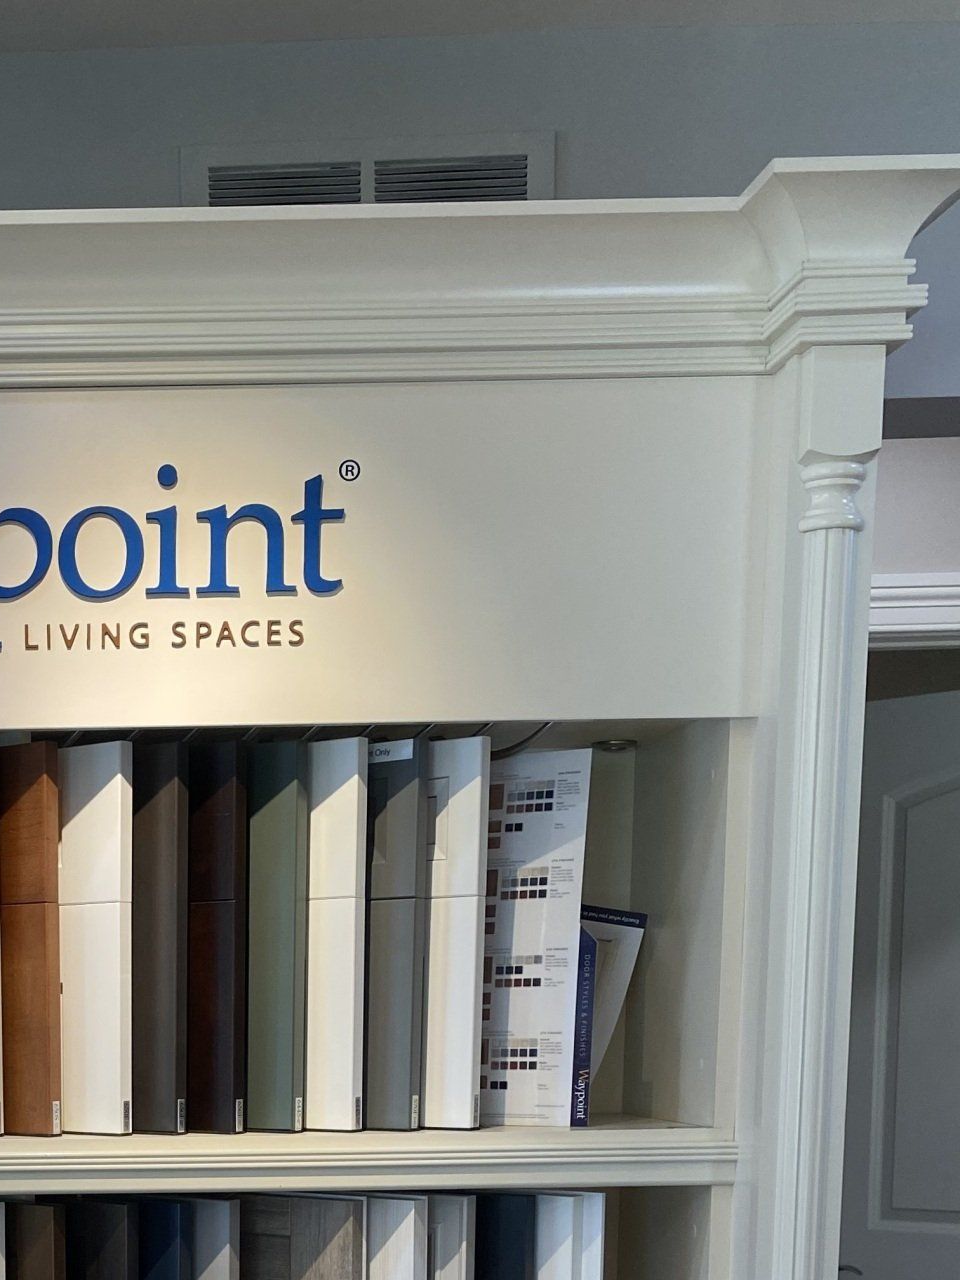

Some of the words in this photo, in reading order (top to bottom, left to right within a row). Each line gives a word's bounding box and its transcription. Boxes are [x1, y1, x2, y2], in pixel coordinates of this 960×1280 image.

[24, 622, 150, 650] LIVING
[171, 619, 305, 648] SPACES
[374, 748, 391, 757] Only
[583, 954, 591, 977] DOOR
[582, 981, 590, 1009] STYLES
[579, 1020, 588, 1057] FINISHES
[574, 1069, 590, 1119] Waypoint
